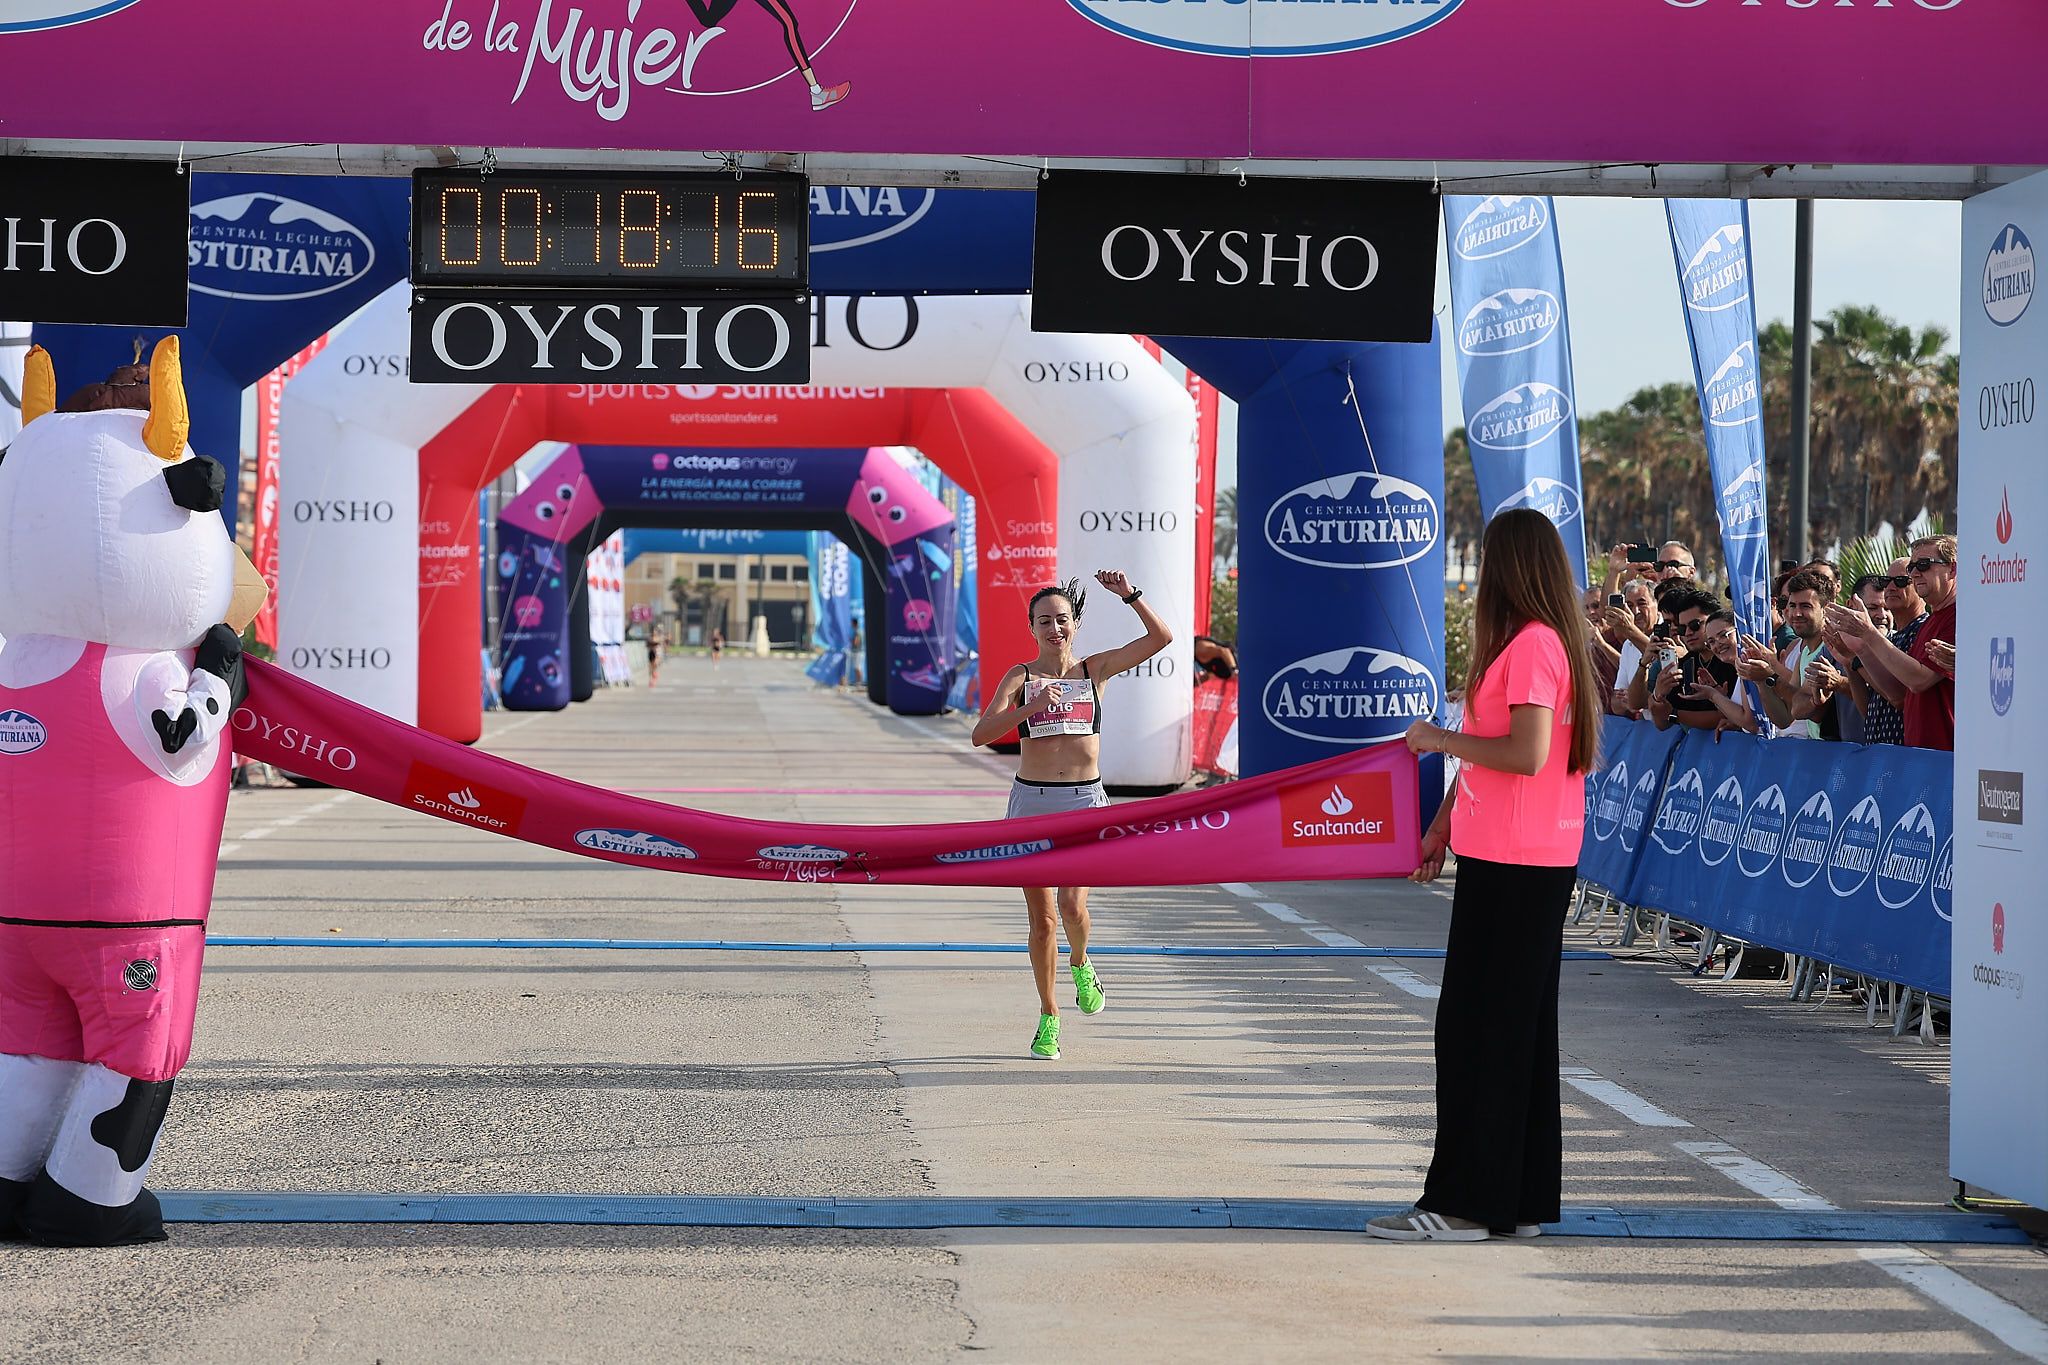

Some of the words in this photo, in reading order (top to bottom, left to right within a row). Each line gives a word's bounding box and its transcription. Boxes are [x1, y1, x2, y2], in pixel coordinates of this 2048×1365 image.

[423, 0, 472, 50] de
[484, 0, 519, 52] la
[511, 0, 727, 121] Mujer
[191, 226, 267, 240] CENTRAL
[275, 232, 352, 247] LECHERA
[441, 188, 778, 269] 00:18:16
[1101, 225, 1379, 290] OYSHO
[1986, 266, 2031, 304] ASTURIANA
[431, 302, 790, 372] OYSHO
[1024, 361, 1129, 383] OYSHO
[1979, 377, 2034, 431] OYSHO
[641, 477, 658, 488] LA
[715, 479, 750, 489] PARA
[294, 500, 393, 523] OYSHO
[1080, 510, 1177, 533] OYSHO
[1276, 508, 1431, 544] ASTURIANA
[1305, 505, 1369, 514] CENTRAL
[1376, 504, 1428, 514] LECHERA
[1007, 520, 1054, 537] Sports
[1981, 552, 2027, 585] Santander
[291, 647, 391, 670] OYSHO
[1274, 682, 1430, 719] ASTURIANA
[1302, 681, 1367, 689] CENTRAL
[1373, 679, 1427, 688] LECHERA
[230, 706, 357, 771] OYSHO
[413, 792, 507, 829] Santander
[1980, 780, 2020, 817] Neutrogena
[1293, 818, 1383, 837] Santander
[1830, 830, 1873, 873] ASTURIANA
[1878, 838, 1927, 884] ASTURIANA
[783, 861, 843, 883] Mujer
